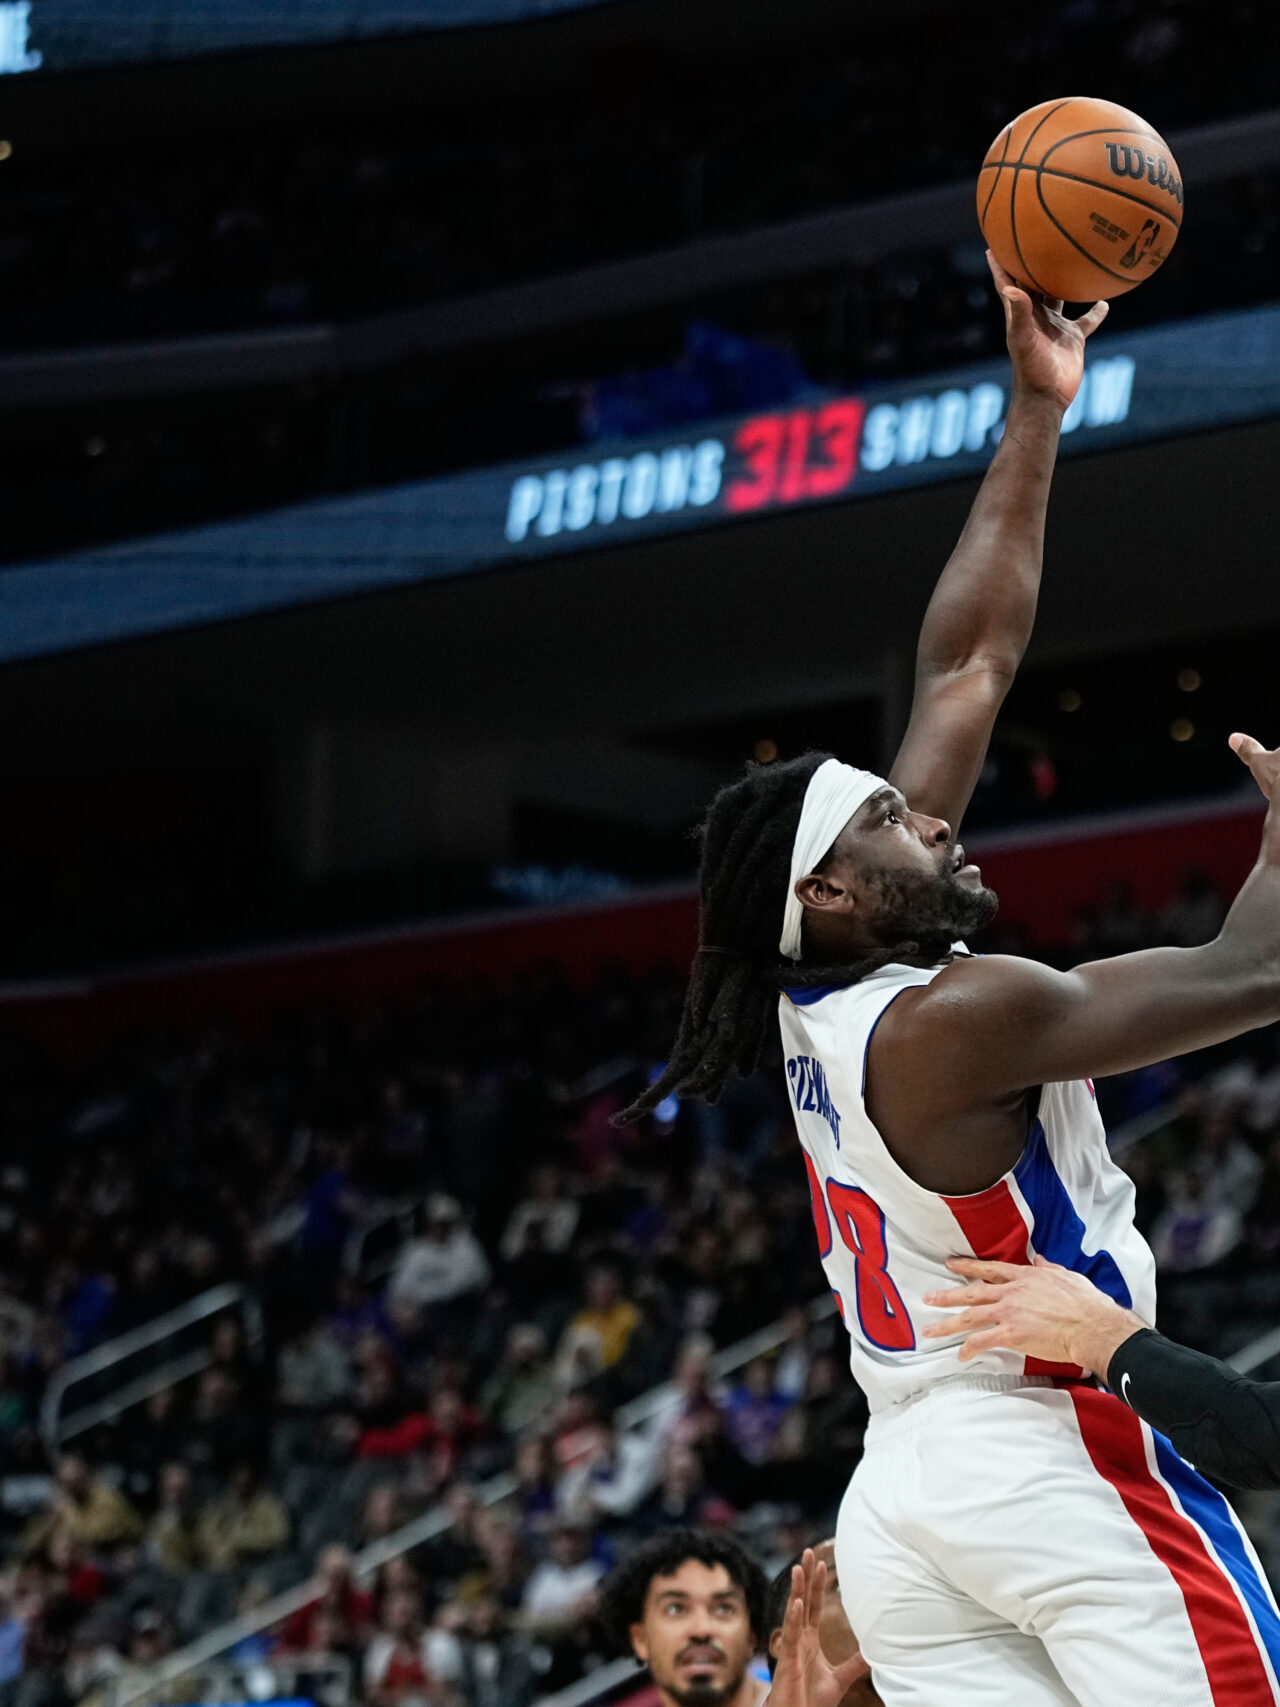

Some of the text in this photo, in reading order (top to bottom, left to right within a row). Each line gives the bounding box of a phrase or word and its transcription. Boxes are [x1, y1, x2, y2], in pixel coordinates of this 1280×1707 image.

[1104, 142, 1184, 205] Wilso
[505, 438, 725, 543] PISTONS
[726, 397, 865, 513] 313
